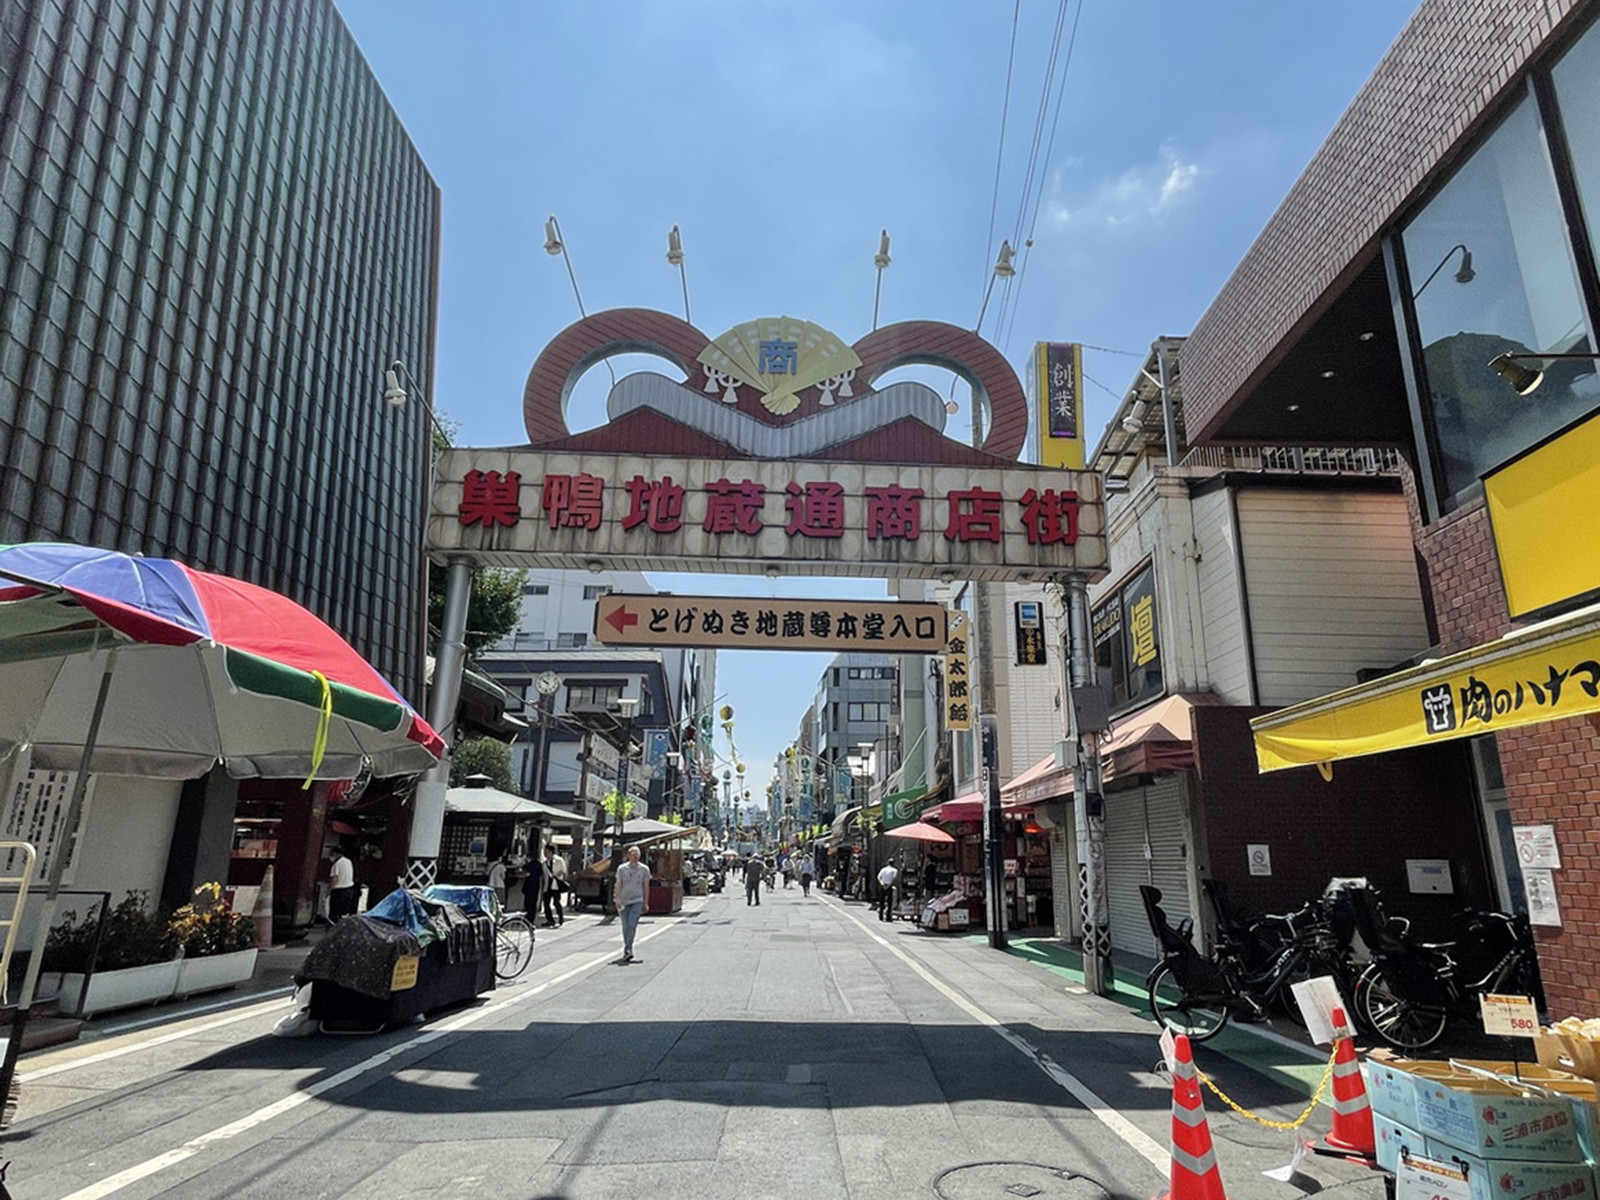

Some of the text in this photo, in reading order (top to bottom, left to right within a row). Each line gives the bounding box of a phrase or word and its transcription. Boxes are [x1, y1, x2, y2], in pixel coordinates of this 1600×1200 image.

[758, 337, 798, 376] 商
[1053, 362, 1073, 416] 創業
[458, 469, 1080, 546] 巣鴨地蔵通商店街
[649, 606, 936, 640] とげぬき地蔵尊本堂入口
[948, 637, 969, 721] 金太郎飴
[1460, 660, 1600, 729] 肉のハナマ
[1511, 1018, 1533, 1029] 580
